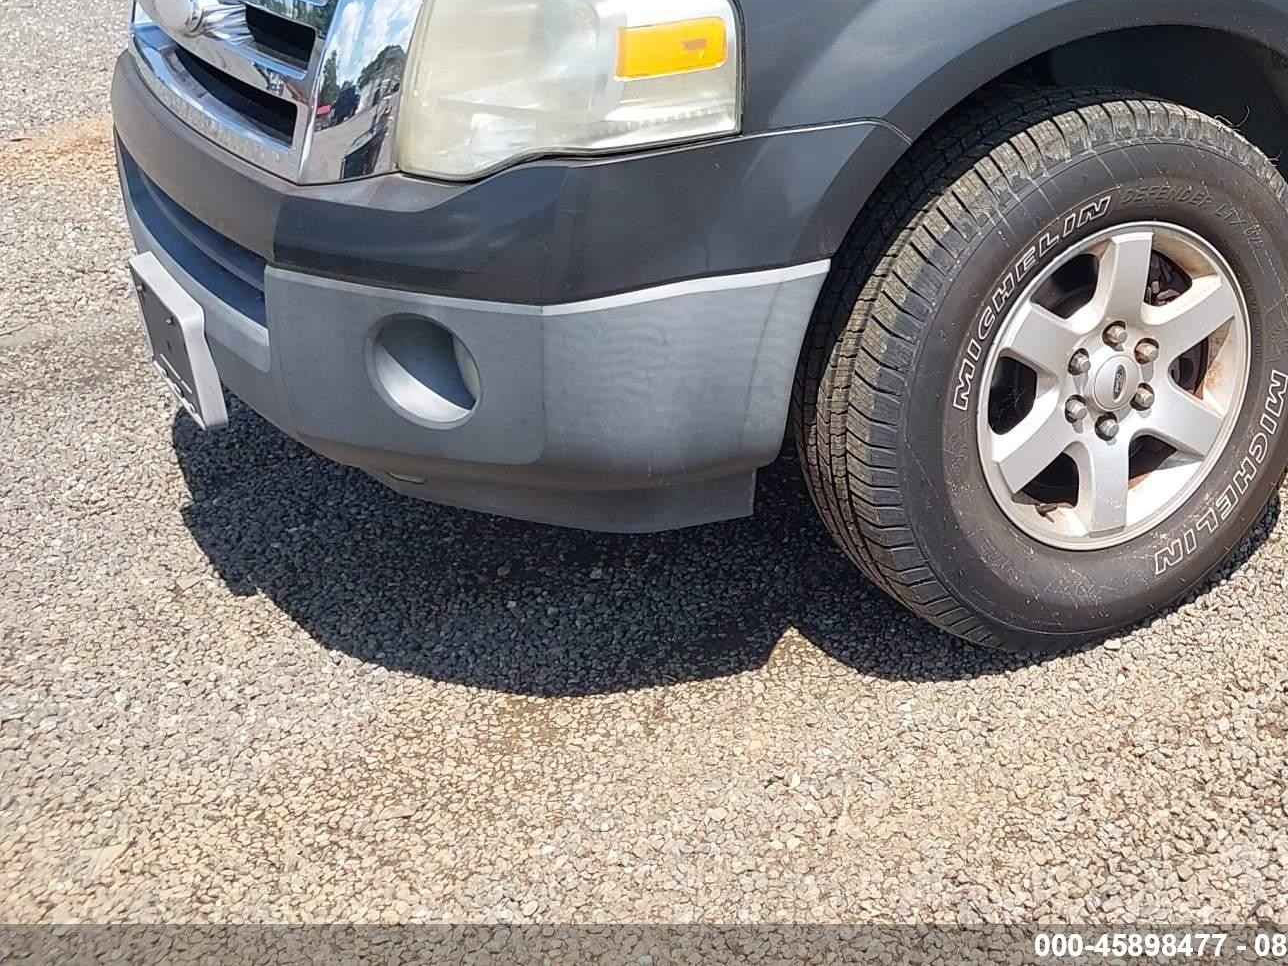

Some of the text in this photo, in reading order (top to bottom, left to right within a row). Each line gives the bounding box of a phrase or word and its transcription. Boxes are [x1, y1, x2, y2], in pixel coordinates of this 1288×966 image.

[953, 195, 1112, 411] MICHELIN
[1121, 186, 1212, 209] DEFENDER
[1155, 370, 1288, 574] MICHELIN
